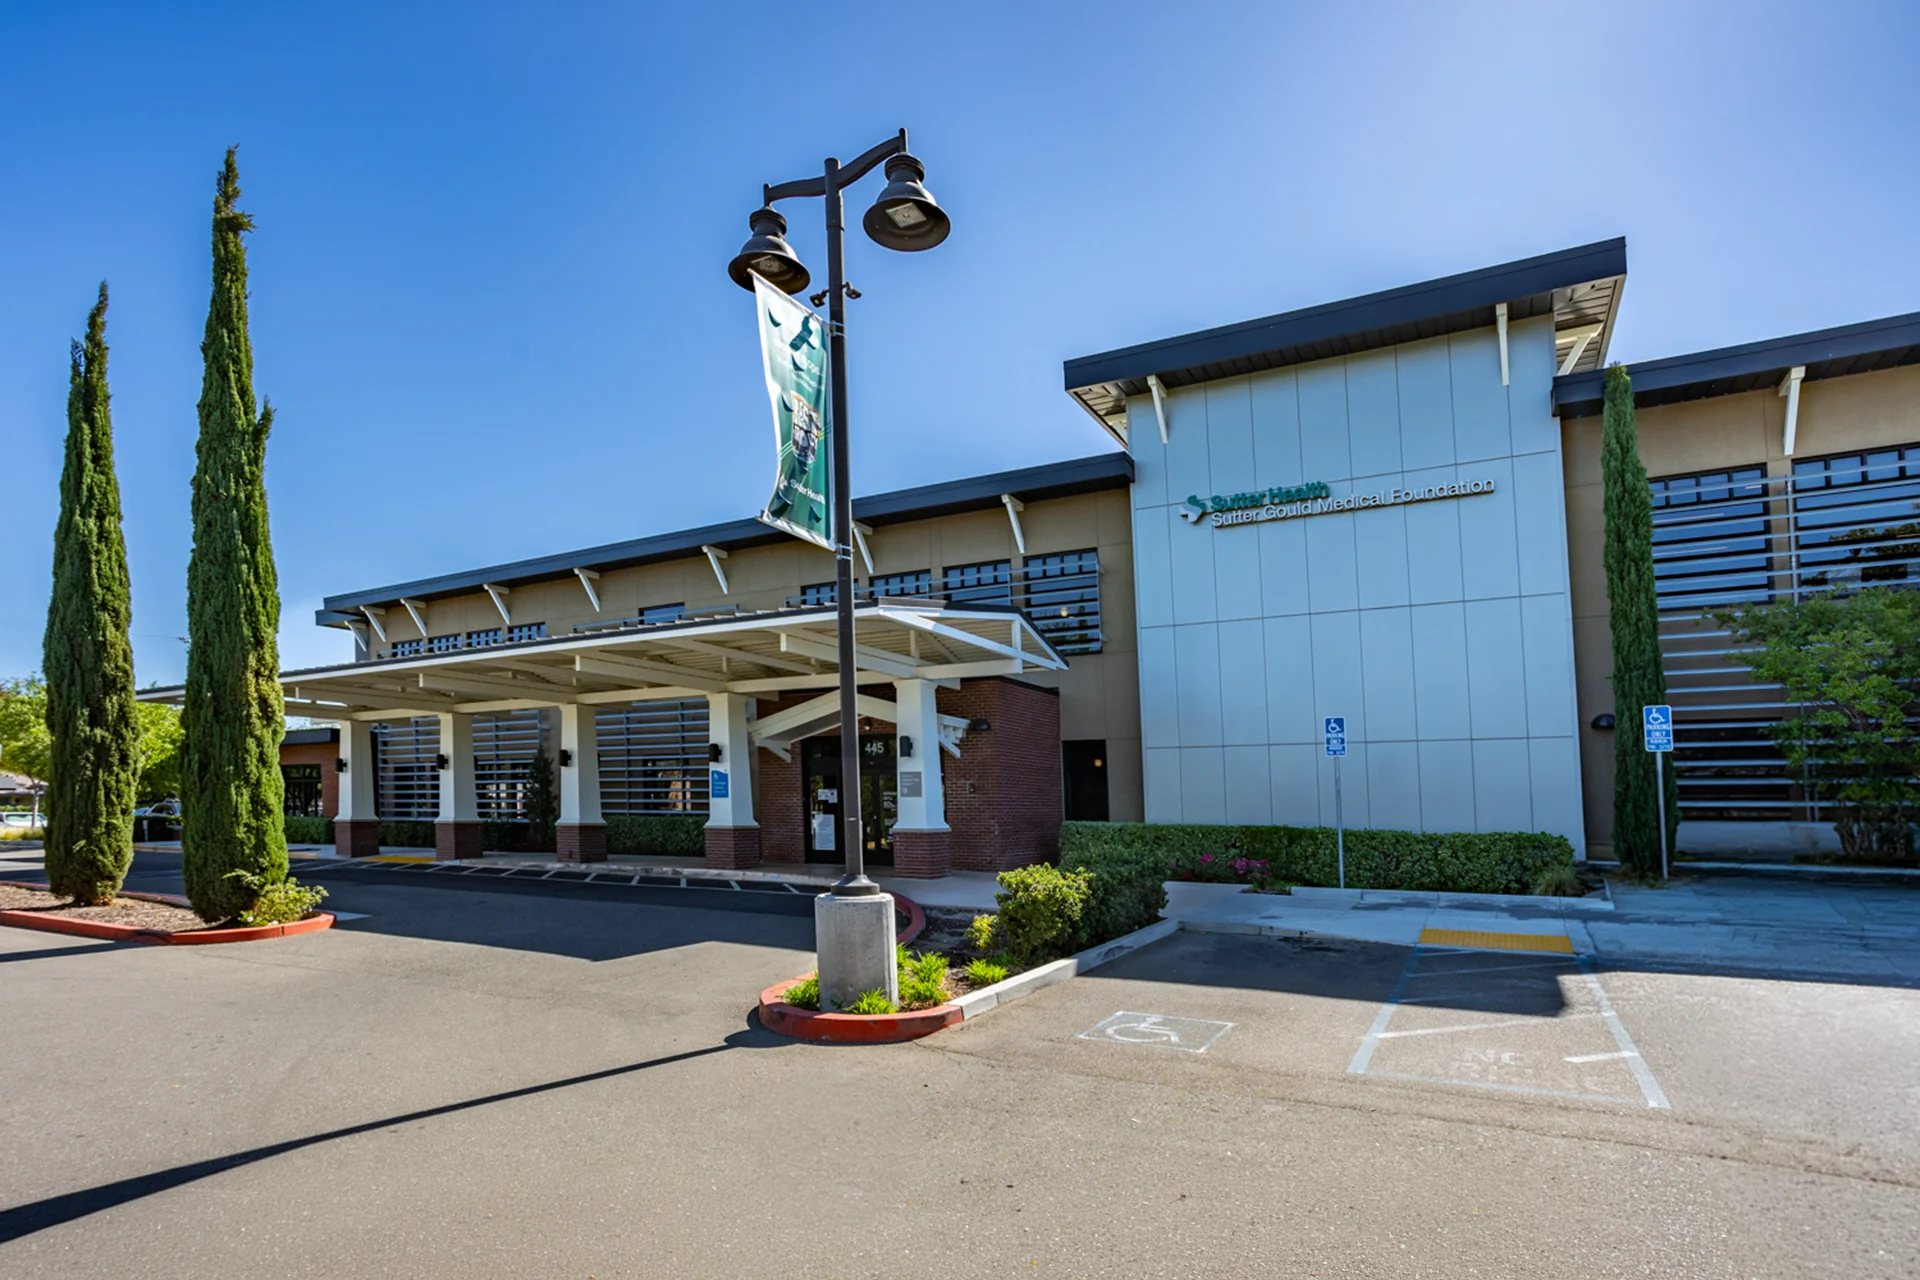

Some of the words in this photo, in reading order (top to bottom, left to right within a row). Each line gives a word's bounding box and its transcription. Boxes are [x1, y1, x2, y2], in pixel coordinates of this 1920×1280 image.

[1210, 491, 1266, 512] Sutter
[1268, 481, 1330, 504] Health
[1211, 510, 1260, 527] Sutter
[1263, 499, 1312, 519] Gould
[1317, 490, 1385, 514] Medical
[1391, 479, 1495, 503] Foundation
[864, 742, 884, 753] 445
